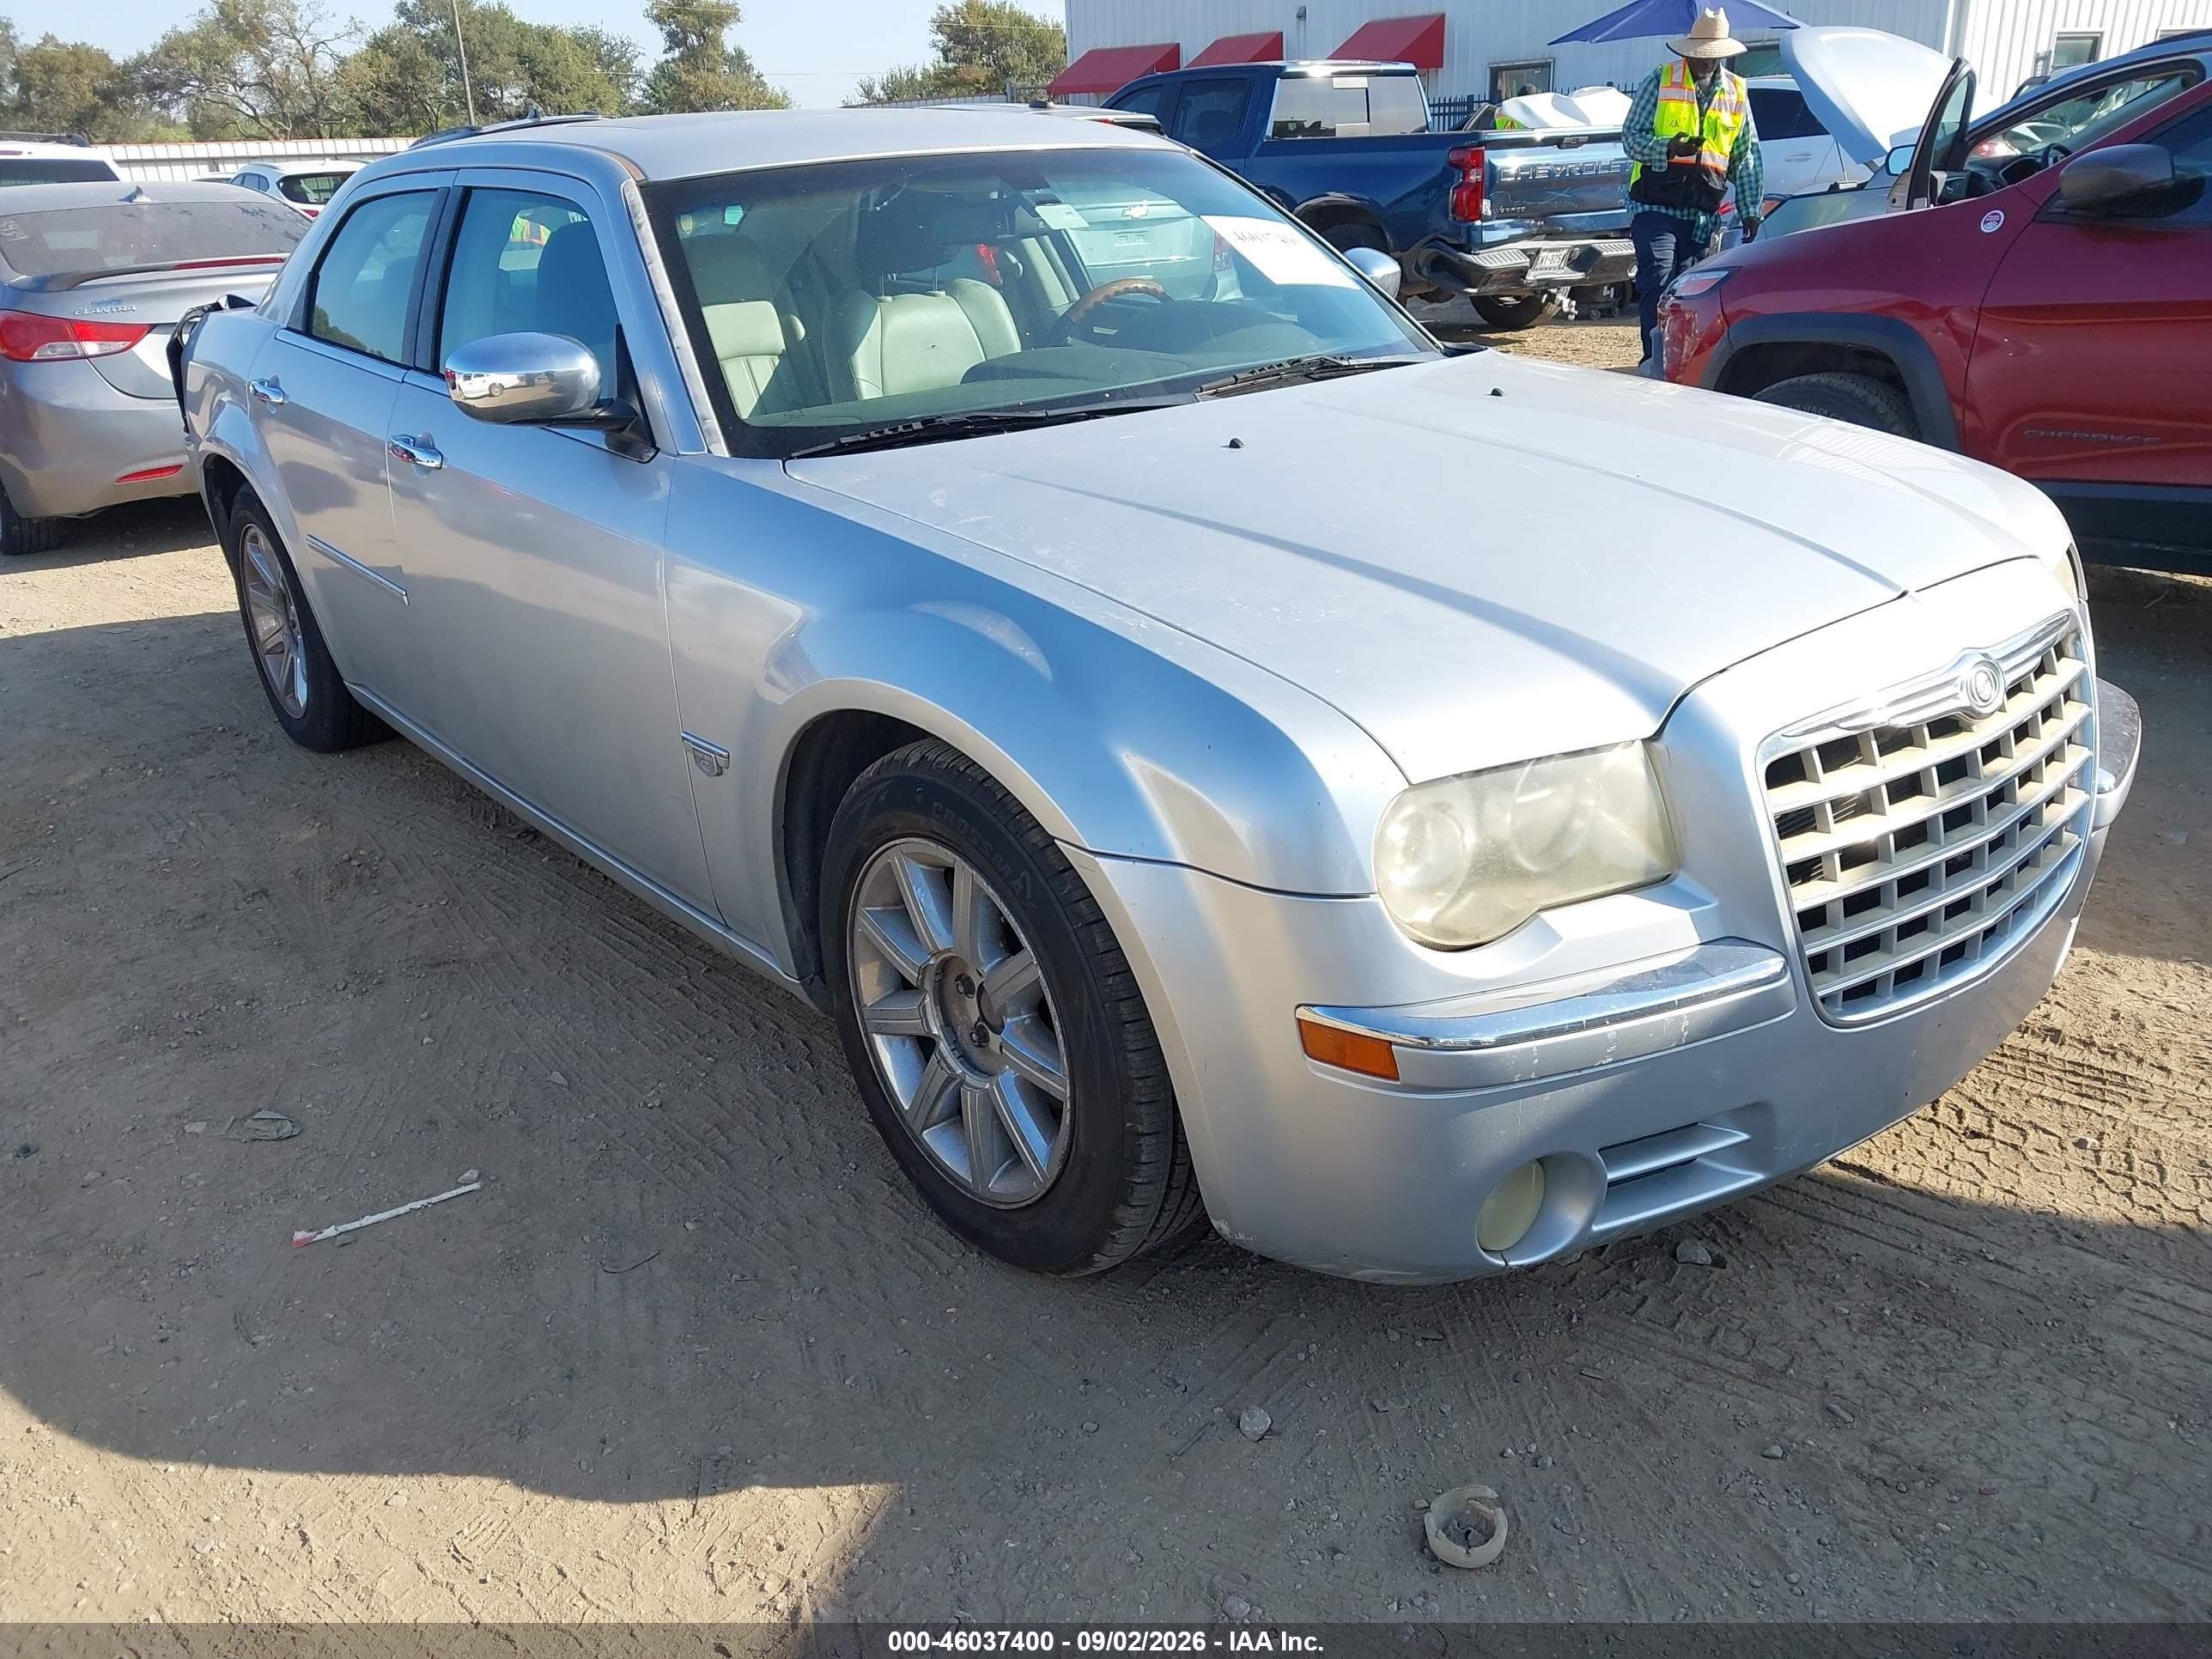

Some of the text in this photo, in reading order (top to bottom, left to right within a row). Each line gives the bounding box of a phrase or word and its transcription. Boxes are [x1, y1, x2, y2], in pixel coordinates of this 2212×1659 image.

[1499, 159, 1634, 182] CHEVROLET
[74, 304, 137, 316] ELANTRA
[2023, 429, 2162, 445] CHEROKEE
